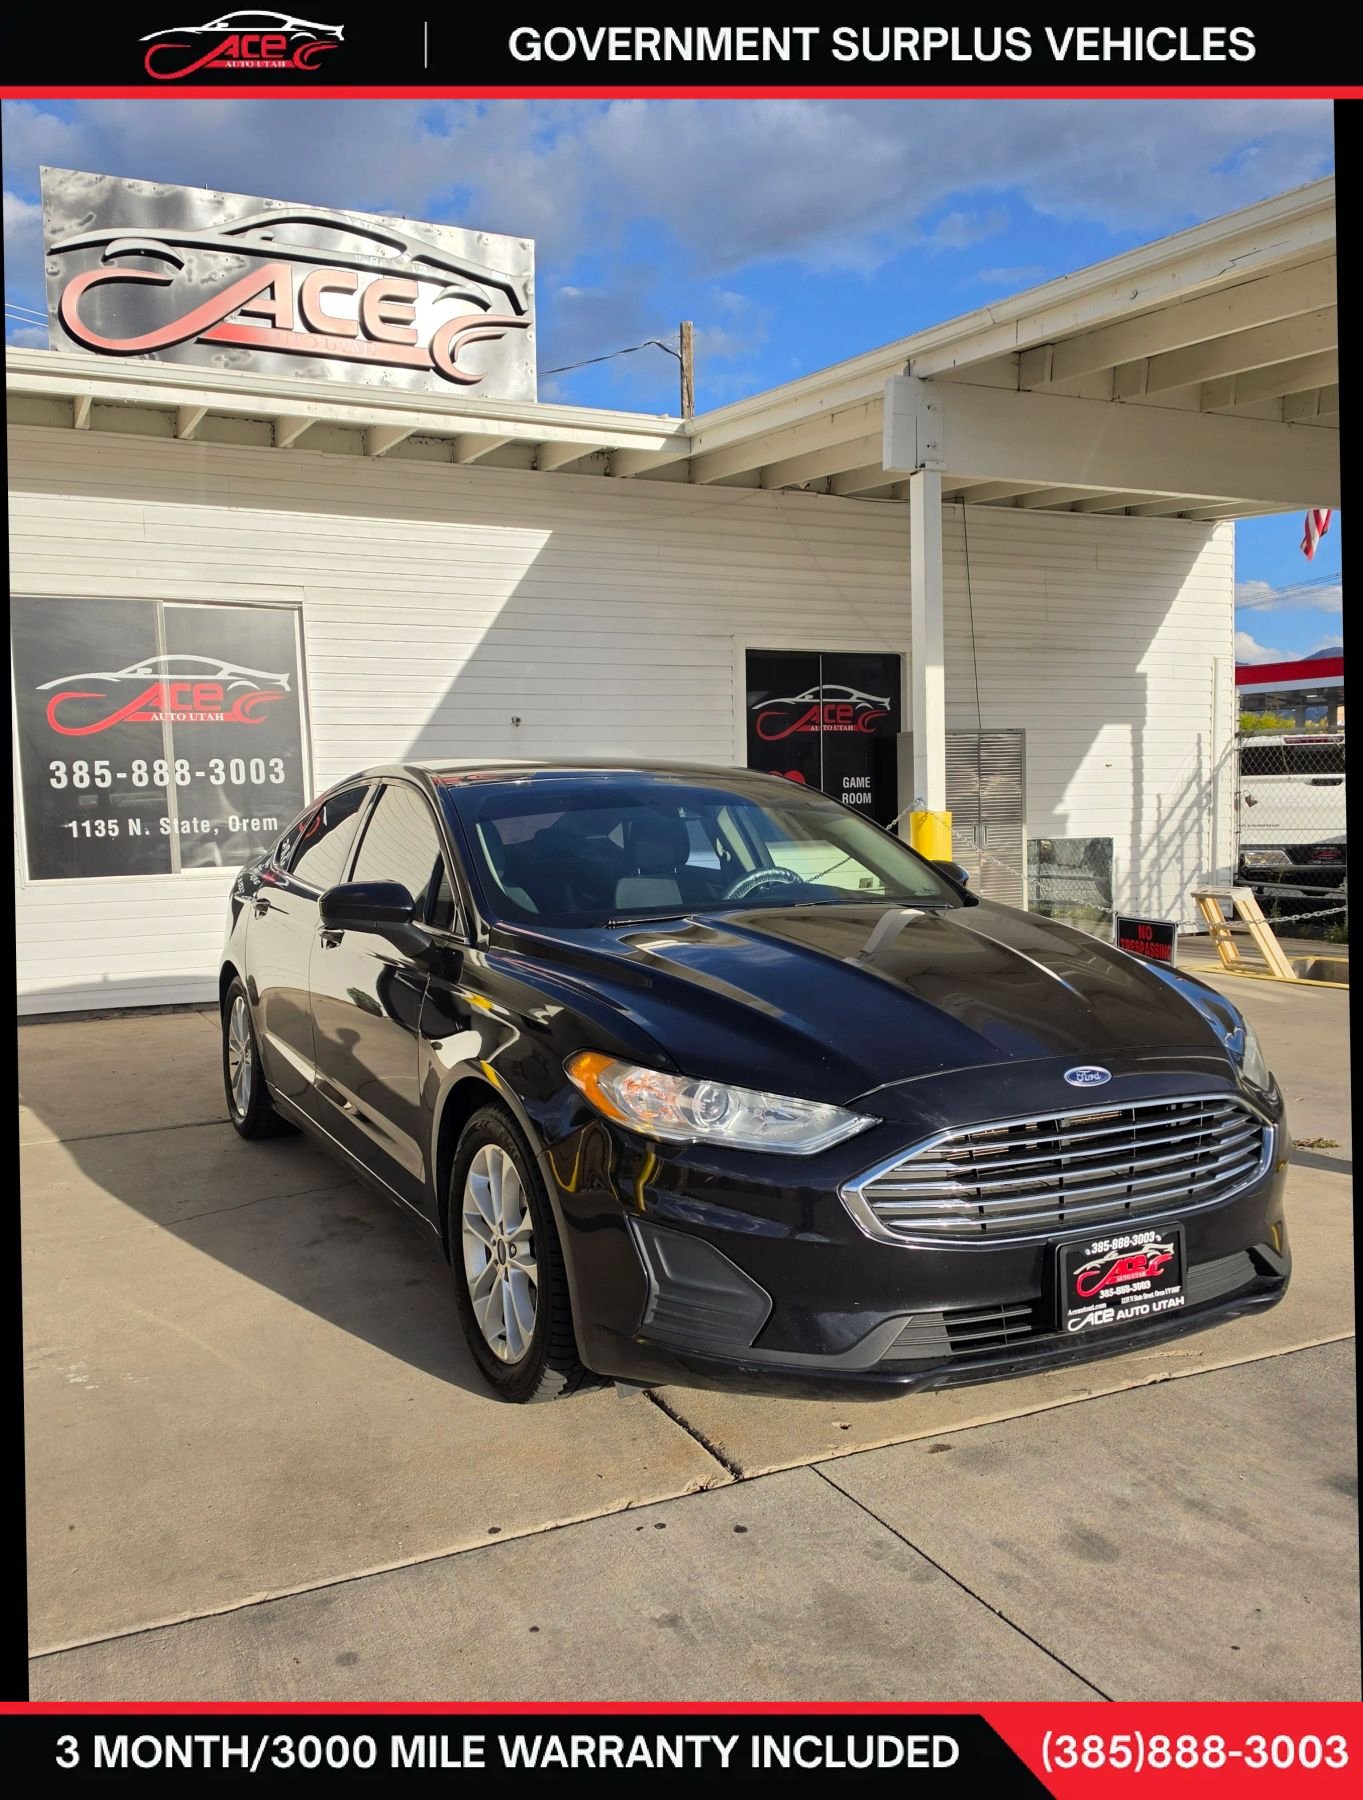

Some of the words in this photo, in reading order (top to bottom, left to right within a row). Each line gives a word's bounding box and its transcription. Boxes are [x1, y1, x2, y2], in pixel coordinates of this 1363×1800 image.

[151, 712, 186, 722] AUTO
[189, 712, 224, 721] UTAH
[49, 757, 286, 789] 385-888-3003
[842, 776, 871, 789] GAME
[842, 793, 872, 805] ROOM
[68, 819, 119, 839] 1135
[128, 818, 151, 836] N.
[228, 815, 278, 833] Orem
[1137, 925, 1153, 941] NO
[1076, 1070, 1101, 1082] Ford
[1091, 1231, 1155, 1254] 385-888-3003
[1116, 1304, 1150, 1320] AUTO
[1152, 1296, 1185, 1312] UTAH
